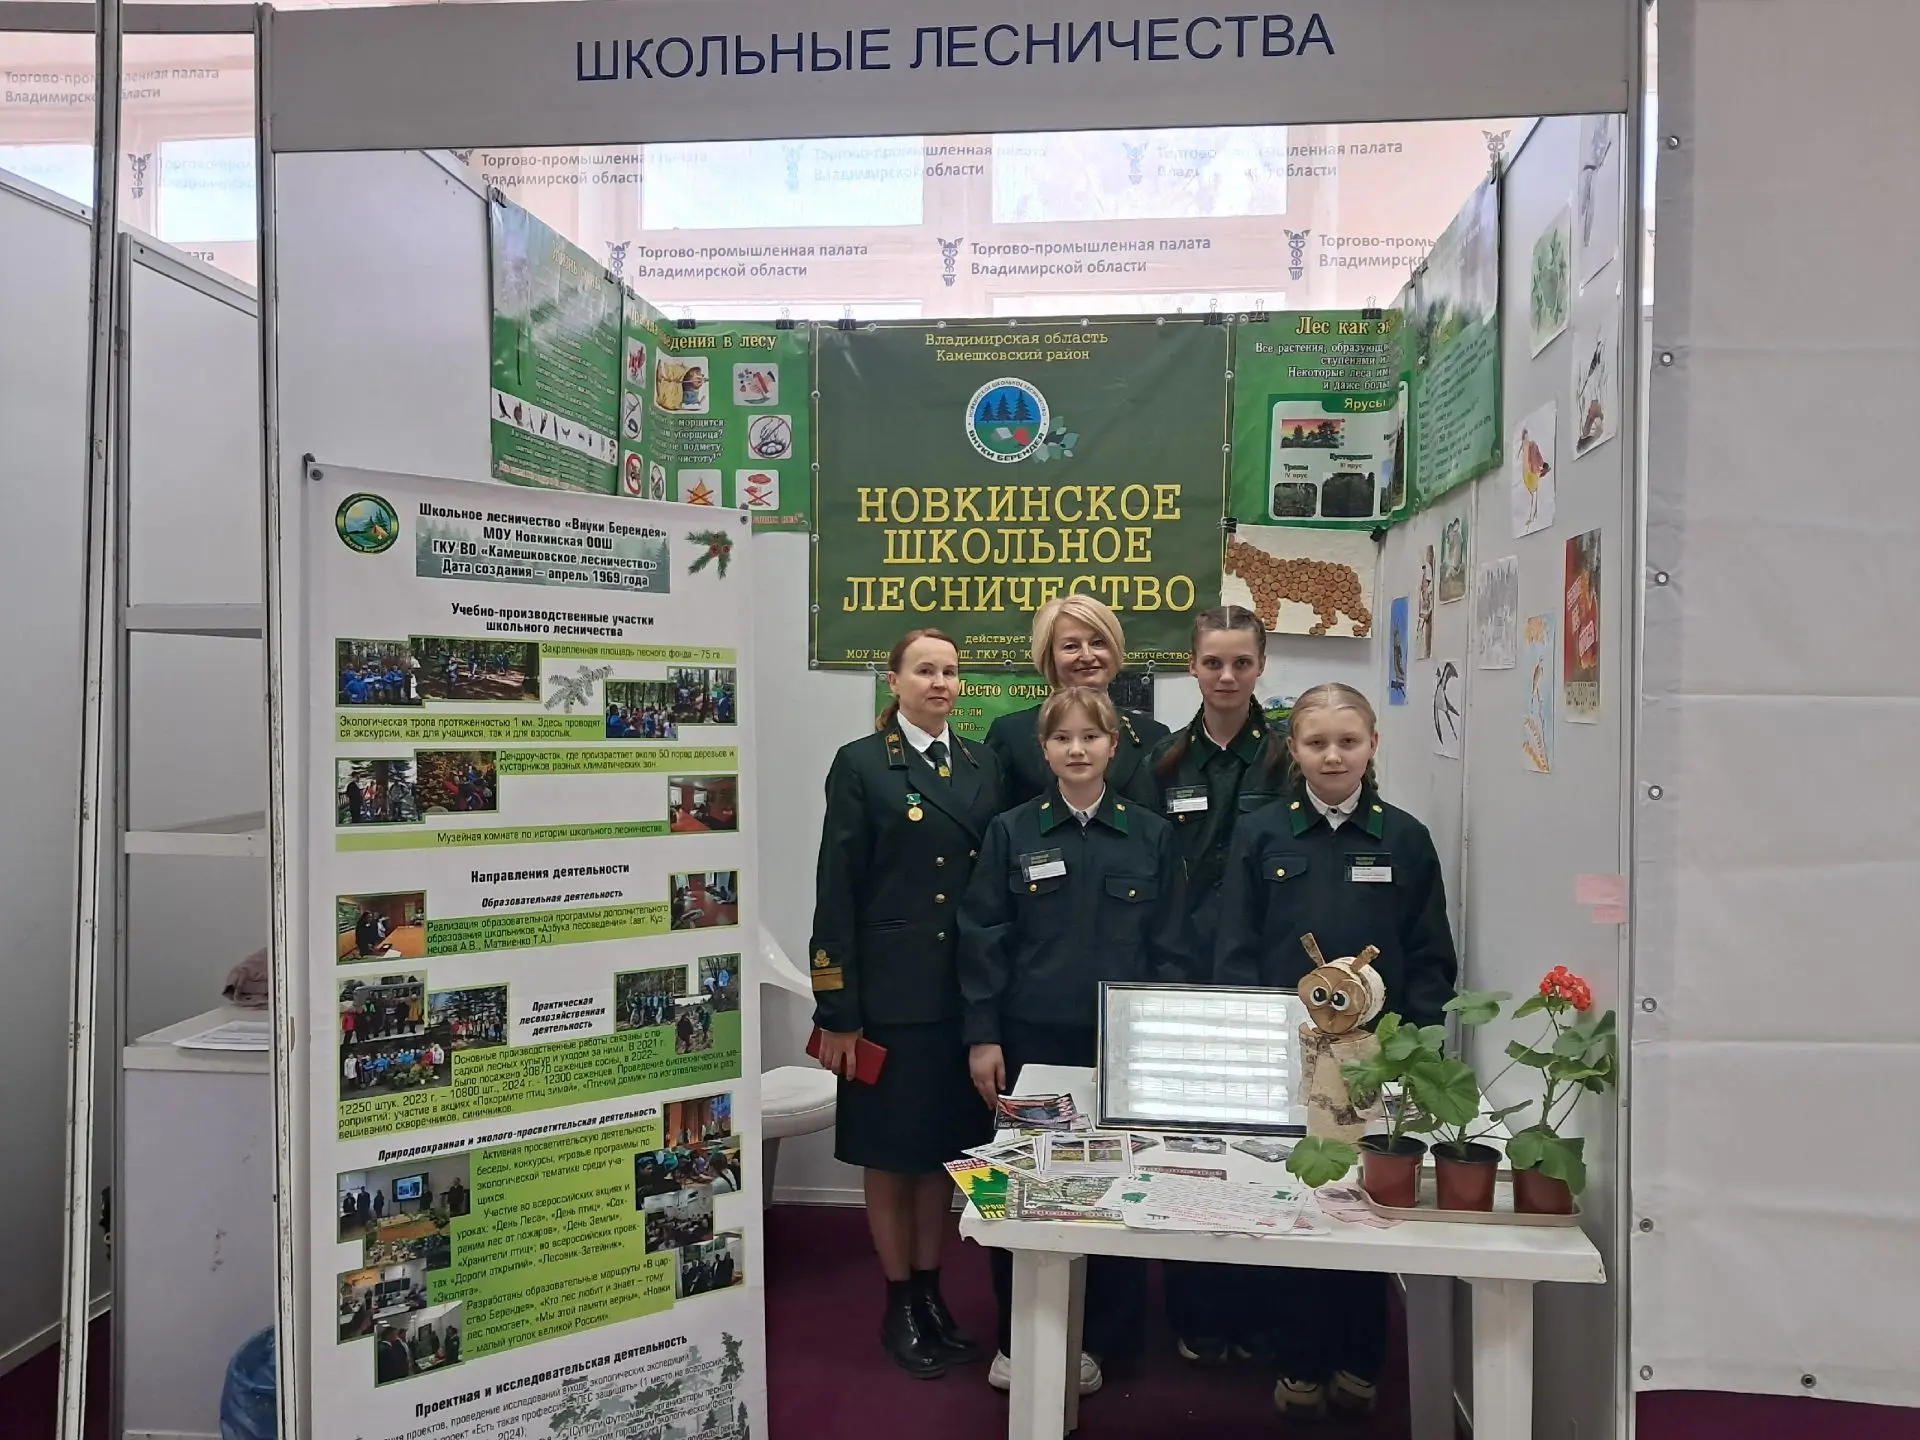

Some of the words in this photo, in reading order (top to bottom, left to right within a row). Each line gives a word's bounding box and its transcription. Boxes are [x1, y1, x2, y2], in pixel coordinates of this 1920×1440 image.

[575, 28, 891, 82] ШКОЛЬНЫЕ
[909, 12, 1336, 70] ЛЕСНИЧЕСТВА
[172, 68, 220, 80] палата
[1349, 141, 1403, 155] палата
[925, 163, 985, 177] области
[638, 244, 815, 260] Торгово-промышленная
[818, 244, 868, 256] палата
[970, 240, 1155, 257] Торгово-промышленная
[1159, 238, 1211, 251] палата
[638, 263, 746, 280] Владимирской
[750, 262, 808, 277] области
[970, 260, 1083, 277] Владимирской
[1087, 260, 1147, 273] области
[1295, 315, 1330, 336] Лес
[1338, 320, 1368, 335] как
[723, 336, 733, 348] в
[739, 335, 777, 351] лесу
[925, 332, 1040, 347] Владимирская
[1043, 331, 1108, 345] область
[936, 348, 1042, 363] Камешковский
[1046, 348, 1090, 362] район
[1255, 342, 1274, 354] Все
[1278, 343, 1327, 355] растения,
[1320, 355, 1376, 367] ступенями
[1288, 366, 1344, 378] Некоторые
[1350, 367, 1372, 378] леса
[1333, 381, 1360, 391] даже
[1344, 398, 1386, 411] Ярусы
[969, 429, 995, 459] ВНУКИ
[997, 432, 1045, 461] БЕРЕНДЕЯ
[856, 483, 1183, 524] НОВКИНСКОЕ
[419, 502, 483, 521] Школьное
[486, 510, 561, 528] лесничество
[565, 517, 605, 533] «Внуки
[608, 521, 667, 539] Берендея»
[483, 526, 511, 540] МОУ
[515, 530, 583, 547] Новкинская
[586, 536, 613, 550] ООШ
[883, 526, 1154, 565] ШКОЛЬНОЕ
[432, 540, 454, 554] ГКУ
[459, 543, 477, 556] ВО
[480, 544, 577, 564] «Камешковское
[580, 554, 656, 571] лесничество»
[442, 559, 471, 576] Дата
[475, 563, 532, 578] создания
[548, 569, 589, 583] апрель
[592, 570, 621, 584] 1969
[623, 575, 648, 587] года
[451, 602, 609, 623] Учебно-производственные
[612, 614, 654, 627] участки
[486, 620, 550, 634] школьного
[553, 623, 623, 637] лесничества
[965, 633, 1025, 645] действует
[541, 643, 599, 655] Закрепленная
[600, 647, 635, 657] площадь
[701, 650, 711, 659] 75
[847, 649, 870, 659] МОУ
[976, 649, 997, 660] ГКУ
[999, 649, 1017, 659] ВО
[1120, 649, 1192, 660] есничество
[970, 707, 982, 716] ли
[340, 715, 408, 727] Экологическая
[411, 718, 436, 728] тропа
[438, 718, 511, 728] протяженностью
[513, 717, 518, 726] 1
[538, 717, 562, 728] Здесь
[340, 729, 351, 737] ся
[353, 729, 403, 739] экскурсии,
[405, 729, 420, 737] как
[423, 729, 439, 738] для
[441, 729, 486, 739] учащихся,
[489, 729, 503, 737] так
[505, 729, 511, 737] и
[513, 729, 528, 739] для
[437, 831, 482, 845] Музейная
[521, 831, 532, 839] по
[534, 829, 568, 840] истории
[569, 827, 613, 838] школьного
[471, 868, 549, 884] Направления
[552, 864, 630, 880] деятельности
[481, 894, 562, 909] Образовательная
[563, 889, 624, 903] деятельность
[427, 920, 479, 932] Реализация
[481, 914, 554, 929] образовательной
[555, 911, 601, 923] программы
[603, 904, 669, 918] дополнительного
[427, 931, 482, 944] образования
[484, 927, 535, 939] школьников
[427, 944, 458, 955] нецова
[483, 937, 531, 949] Матвиенко
[532, 997, 594, 1013] Практическая
[519, 1007, 606, 1026] лесохозяйственная
[532, 1020, 593, 1037] деятельность
[454, 1050, 497, 1065] Основные
[499, 1042, 576, 1059] производственные
[578, 1037, 608, 1049] работы
[340, 1101, 372, 1115] 12250
[374, 1100, 400, 1112] штук.
[403, 1093, 428, 1106] 2023
[450, 1085, 480, 1099] 10800
[502, 1079, 526, 1091] 2024
[544, 1072, 572, 1085] 12300
[378, 1138, 465, 1162] Природоохранная
[467, 1138, 474, 1146] и
[476, 1117, 598, 1144] эколого-просветительская
[598, 1107, 657, 1125] деятельность
[482, 1146, 522, 1160] Активная
[524, 1132, 599, 1154] просветительскую
[483, 1204, 518, 1218] Участие
[532, 1192, 594, 1209] всероссийских
[466, 1289, 523, 1311] Разработаны
[525, 1272, 599, 1297] образовательные
[600, 1263, 641, 1281] маршруты
[415, 1390, 481, 1417] Проектная
[484, 1386, 492, 1397] и
[495, 1356, 611, 1395] исследовательская
[614, 1335, 688, 1364] деятельность
